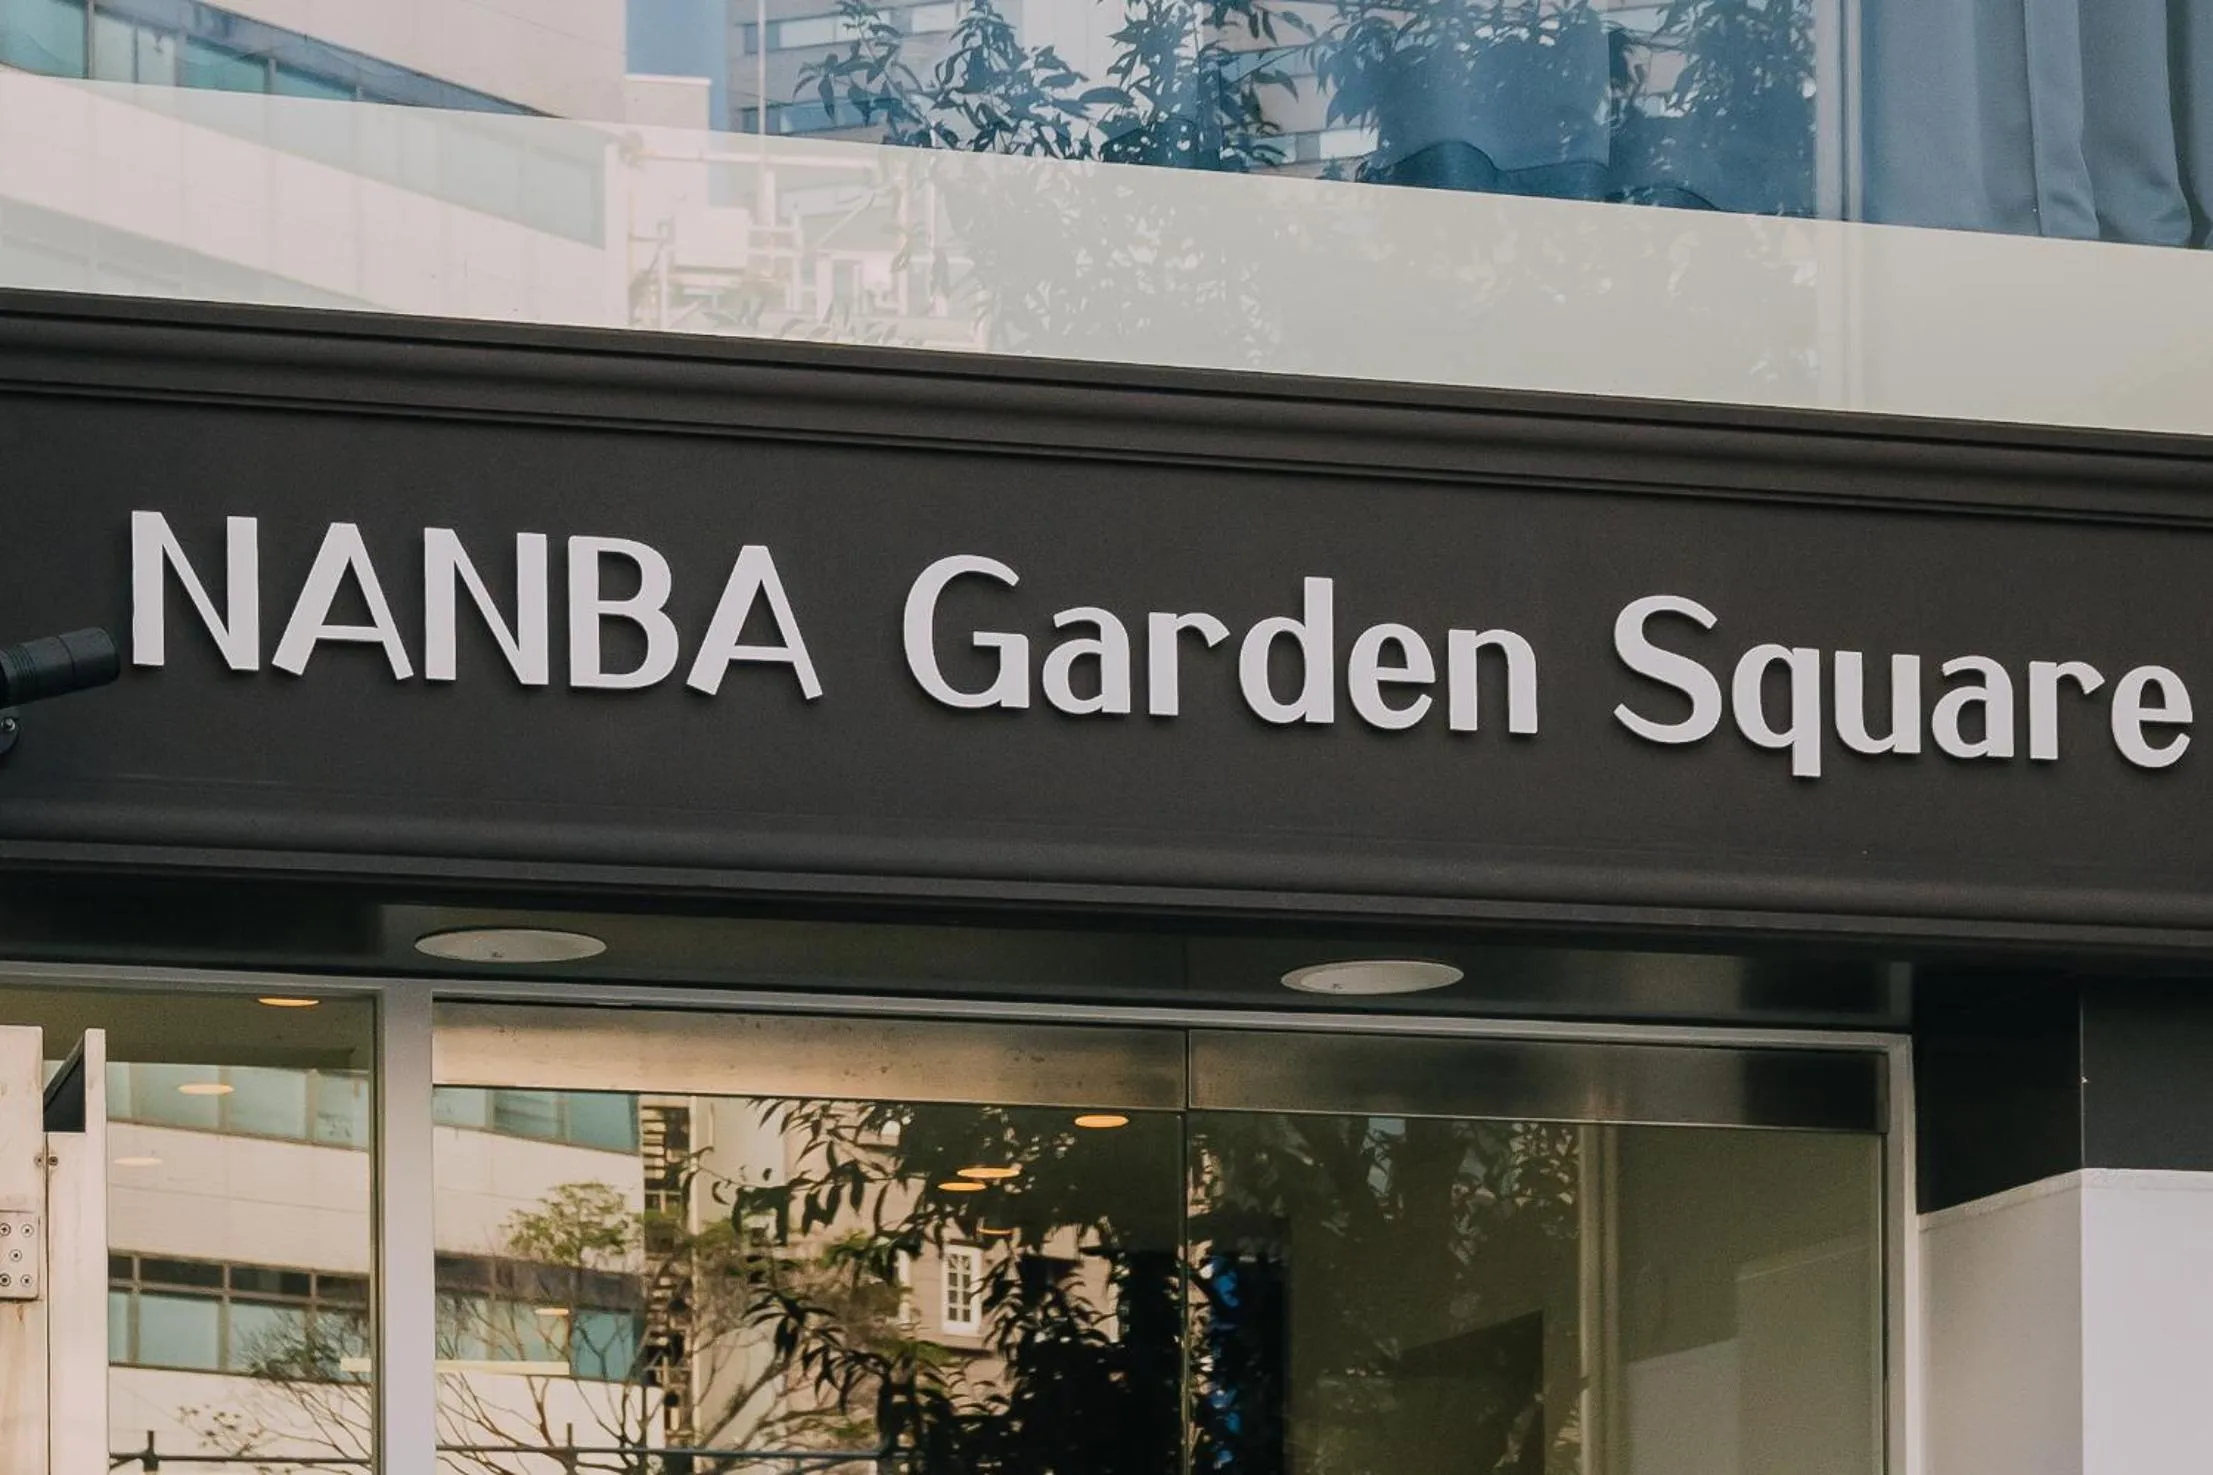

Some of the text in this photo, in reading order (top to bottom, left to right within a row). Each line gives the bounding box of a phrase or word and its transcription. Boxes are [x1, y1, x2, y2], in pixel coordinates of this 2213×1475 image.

[131, 510, 2193, 778] NANBA Garden Square
